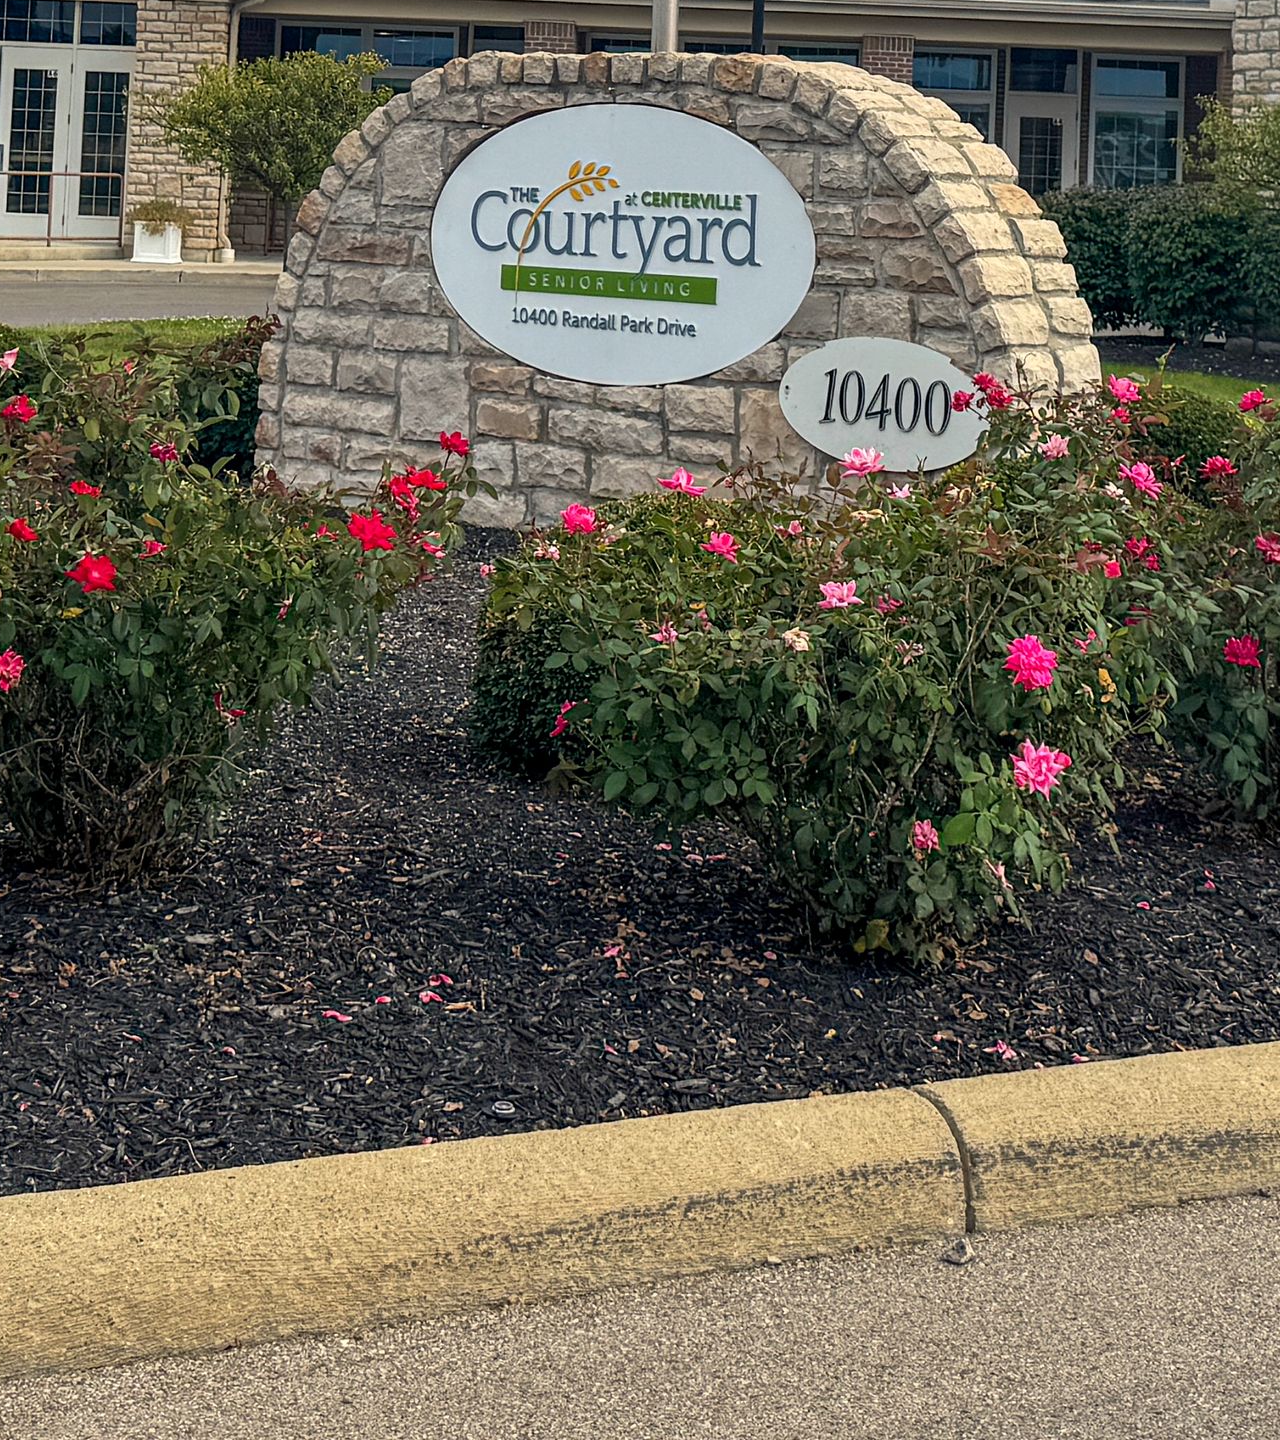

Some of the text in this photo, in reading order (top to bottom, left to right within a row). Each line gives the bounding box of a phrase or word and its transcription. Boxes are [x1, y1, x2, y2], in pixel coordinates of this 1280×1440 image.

[510, 187, 540, 203] THE
[624, 191, 742, 211] at CENTERVILLE
[470, 190, 762, 281] Courtyard
[528, 272, 690, 297] SENIOR LIVING
[511, 306, 697, 338] 10400 Randall Park Drive
[819, 368, 952, 436] 10400
